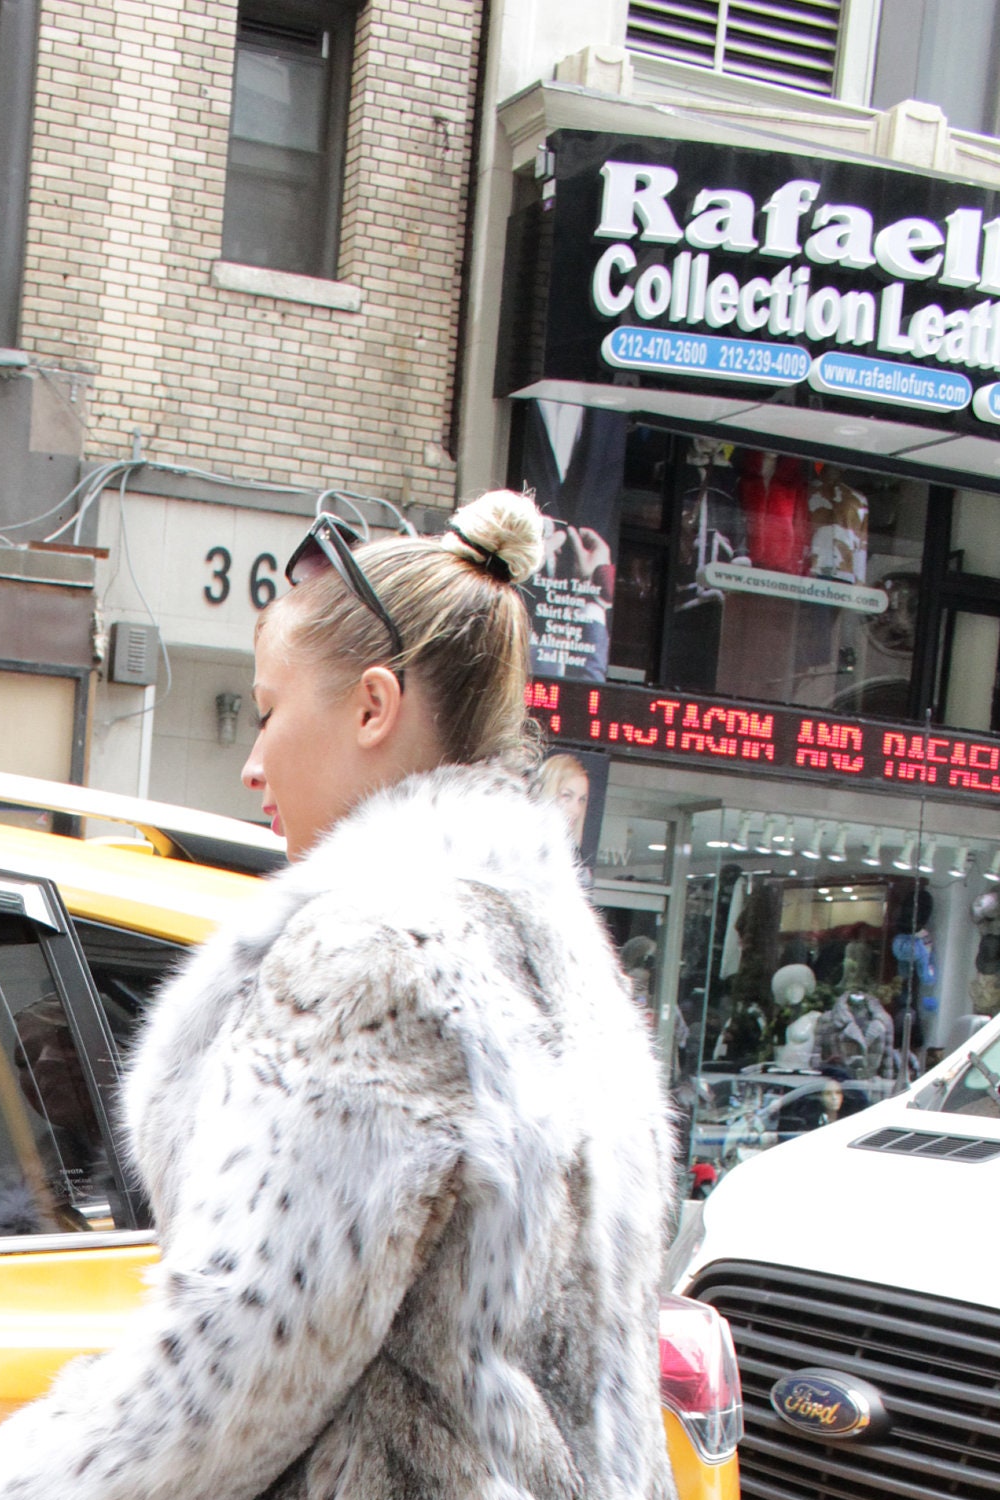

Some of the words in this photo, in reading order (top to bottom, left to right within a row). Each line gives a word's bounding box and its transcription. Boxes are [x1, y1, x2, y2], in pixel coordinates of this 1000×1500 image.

[593, 243, 876, 346] Collection
[877, 282, 1000, 372] Leat
[618, 332, 707, 366] 212-470-2600
[719, 344, 808, 377] 212-239-4009
[823, 362, 967, 404] www.rafaellofurs.com
[533, 573, 568, 591] Expert
[570, 578, 602, 595] Tailor
[546, 590, 586, 608] Custom
[535, 602, 562, 619] Shirt
[562, 606, 572, 621] &
[545, 619, 582, 641] Sewing
[540, 633, 596, 654] Alterations
[536, 648, 557, 663] 2nd
[783, 1382, 841, 1425] Ford
